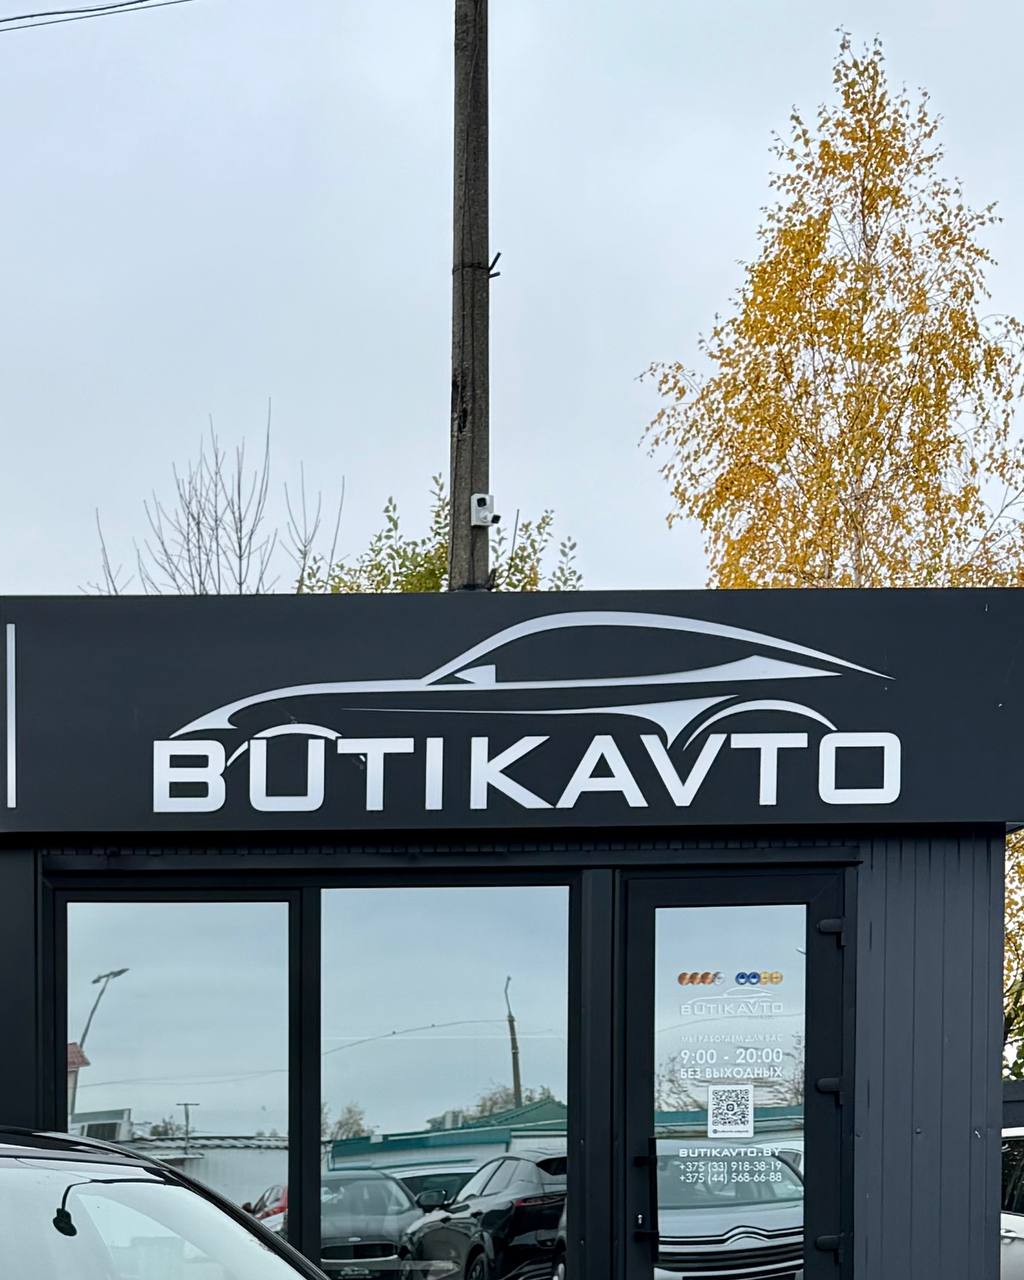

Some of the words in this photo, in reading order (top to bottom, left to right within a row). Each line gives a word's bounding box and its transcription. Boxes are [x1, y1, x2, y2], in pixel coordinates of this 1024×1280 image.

[153, 730, 902, 812] BUTIKAVTO
[680, 1002, 784, 1016] BUTIKAVTO
[681, 1049, 716, 1064] 9:00
[736, 1048, 783, 1064] 20:00
[680, 1068, 701, 1079] БЕЗ
[705, 1067, 783, 1079] ВЫХОДНЫХ
[679, 1148, 781, 1158] BUTIKAVTO.BY
[679, 1162, 705, 1172] +375
[708, 1161, 728, 1173] (33)
[731, 1161, 782, 1172] 918-38-19
[679, 1173, 705, 1183] +375
[708, 1173, 728, 1185] (44)
[731, 1172, 782, 1183] 568-66-88
